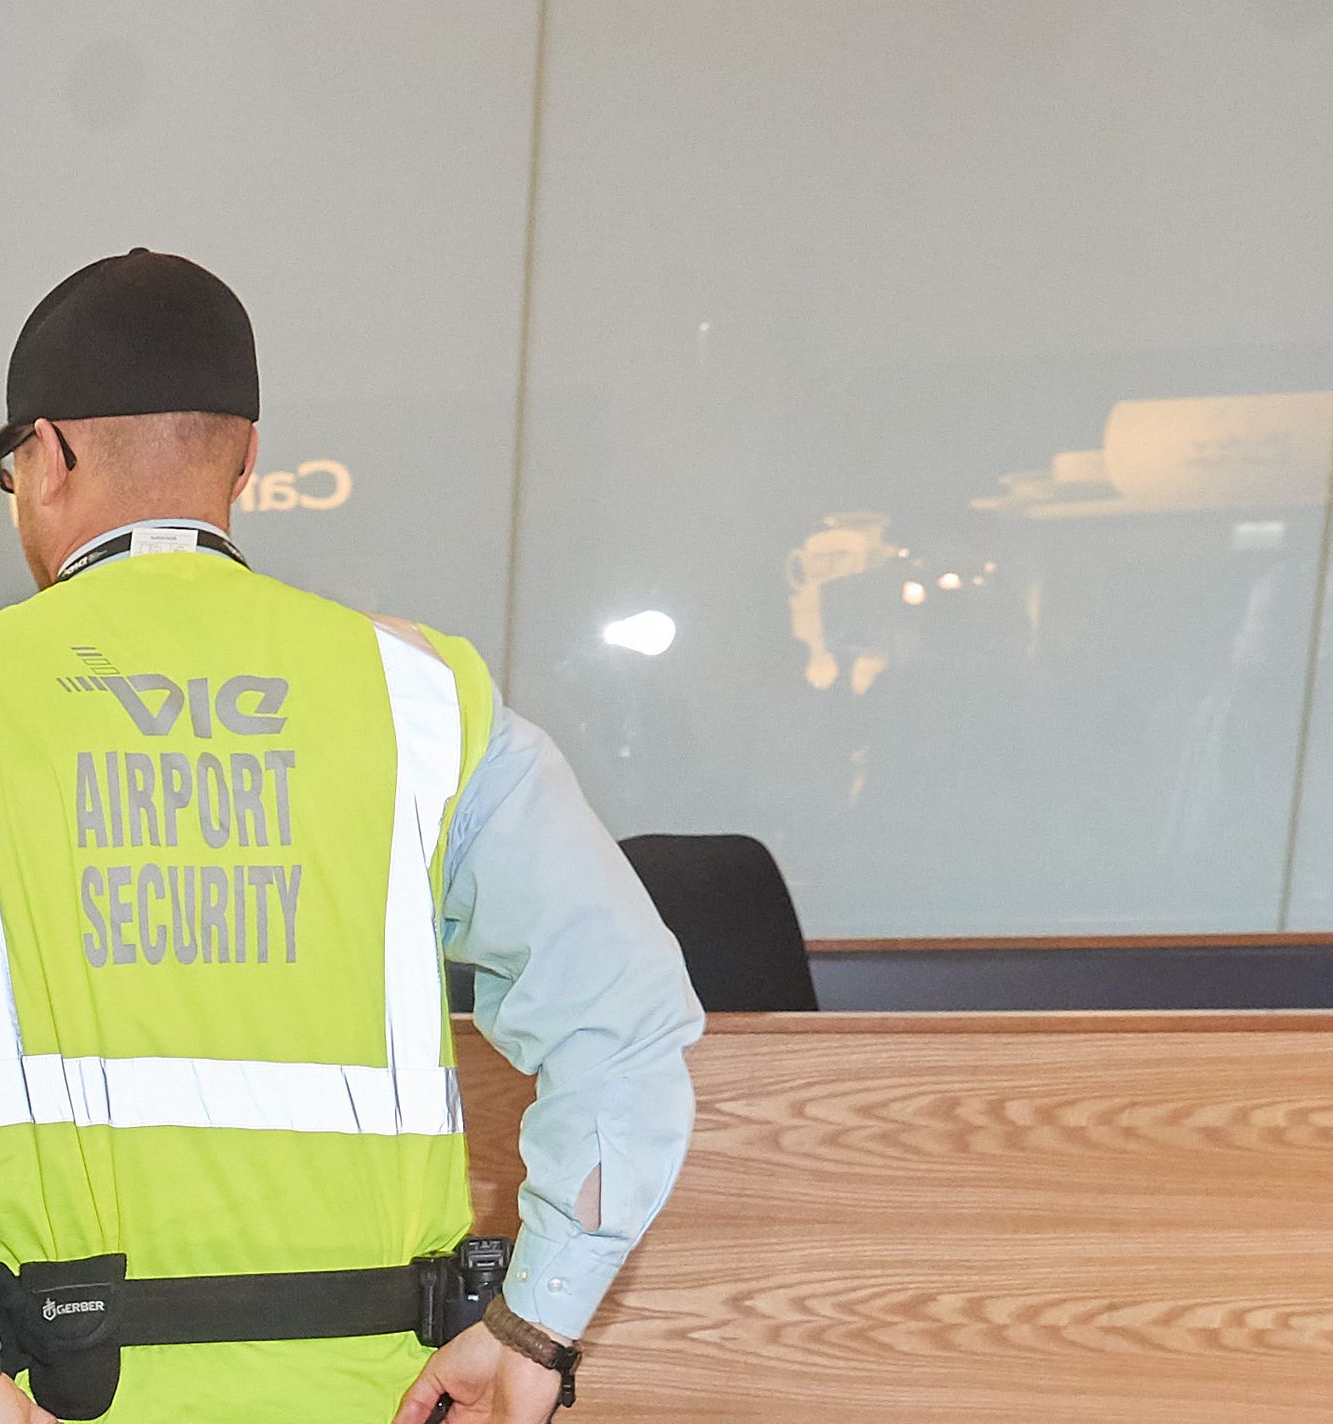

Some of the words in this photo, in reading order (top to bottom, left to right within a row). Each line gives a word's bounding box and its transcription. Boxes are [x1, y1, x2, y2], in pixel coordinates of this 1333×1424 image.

[76, 750, 296, 849] AIRPORT
[83, 863, 302, 968] SECURITY
[57, 1300, 105, 1315] GERBER
